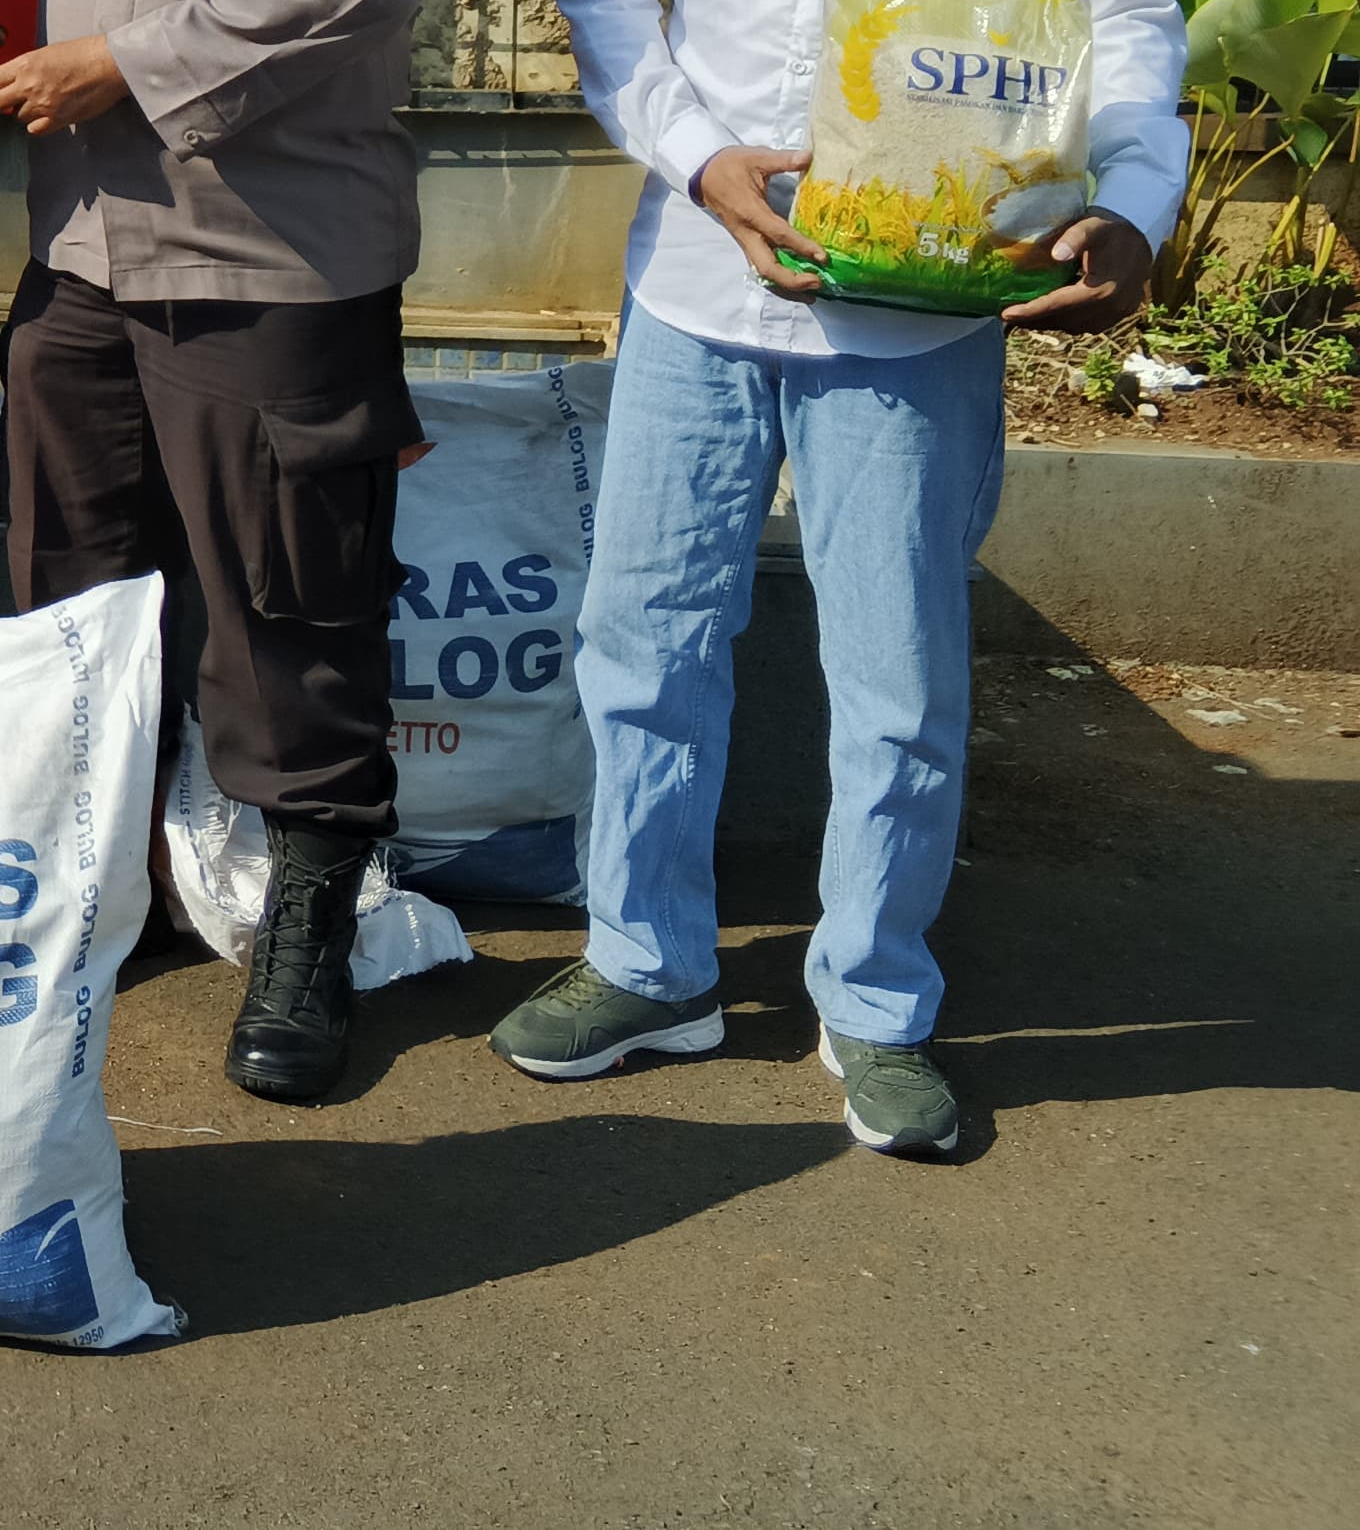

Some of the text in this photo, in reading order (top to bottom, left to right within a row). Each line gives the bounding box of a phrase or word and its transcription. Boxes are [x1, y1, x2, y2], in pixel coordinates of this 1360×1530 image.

[907, 47, 1068, 108] SPHP
[917, 232, 969, 264] 5 kg
[568, 425, 590, 493] BULOG
[389, 554, 558, 620] RAS
[389, 629, 563, 701] LOG
[386, 721, 460, 755] ETTO
[73, 883, 100, 974] BULOG
[71, 985, 92, 1079] BULOG
